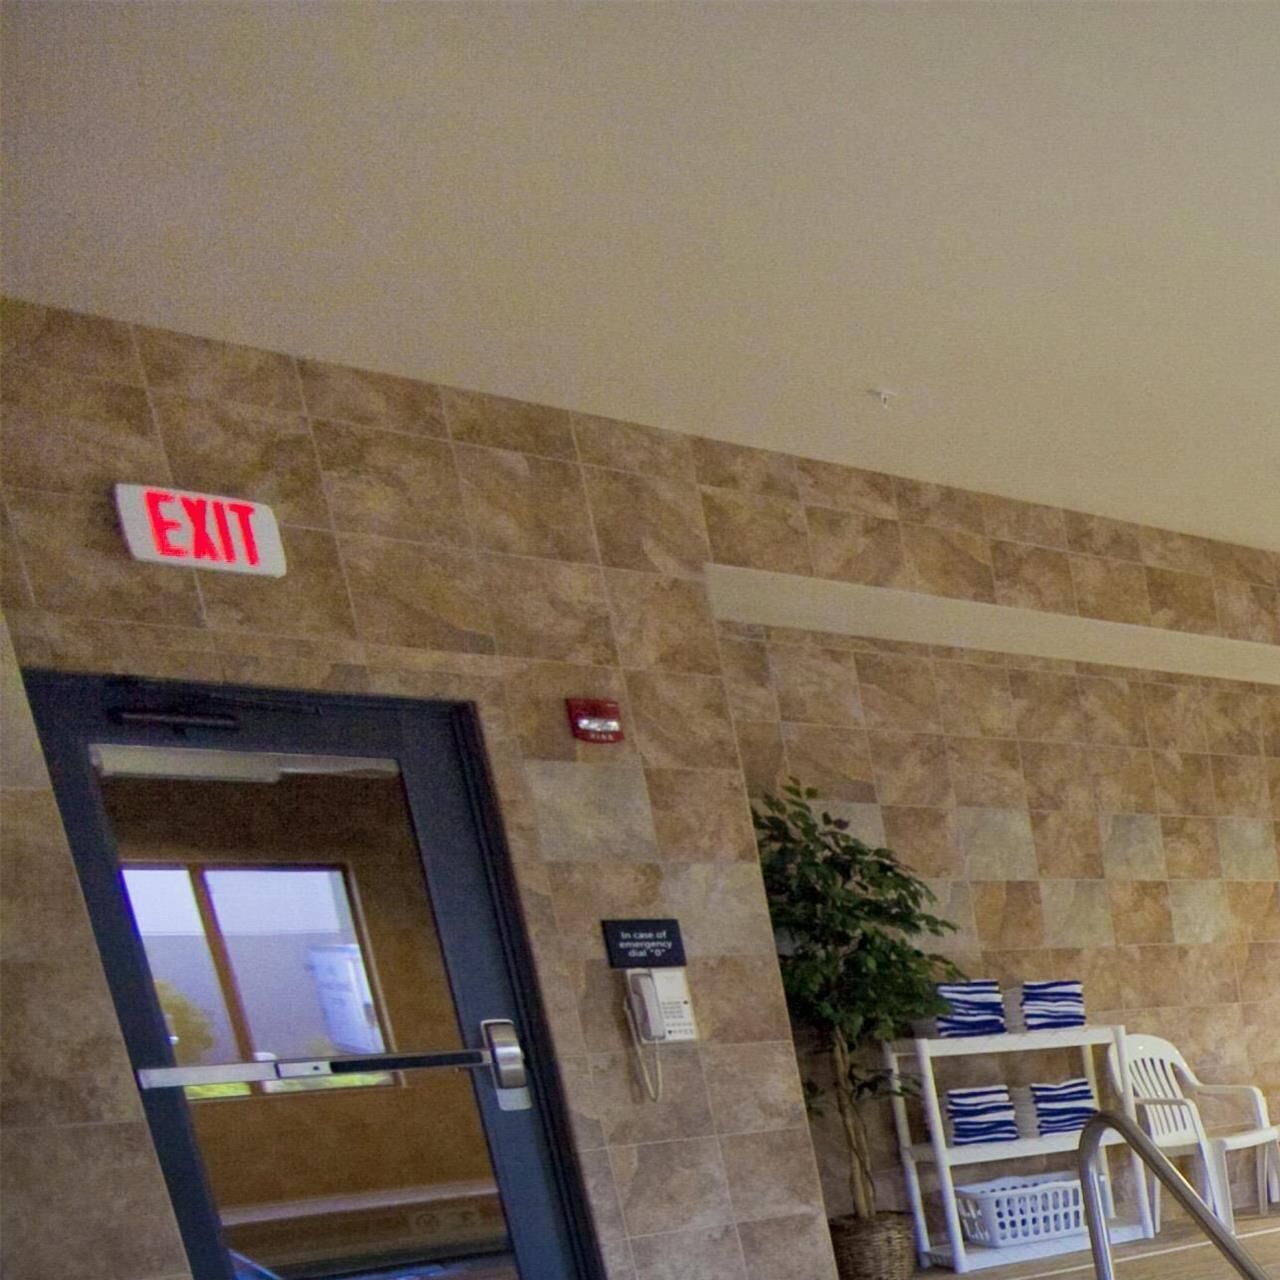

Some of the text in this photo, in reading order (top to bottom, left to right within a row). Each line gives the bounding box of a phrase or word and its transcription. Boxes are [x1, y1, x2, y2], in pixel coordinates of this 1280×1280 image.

[144, 490, 260, 566] EXIT
[620, 930, 667, 940] In case of
[619, 941, 673, 950] emergency
[628, 949, 648, 958] dial
